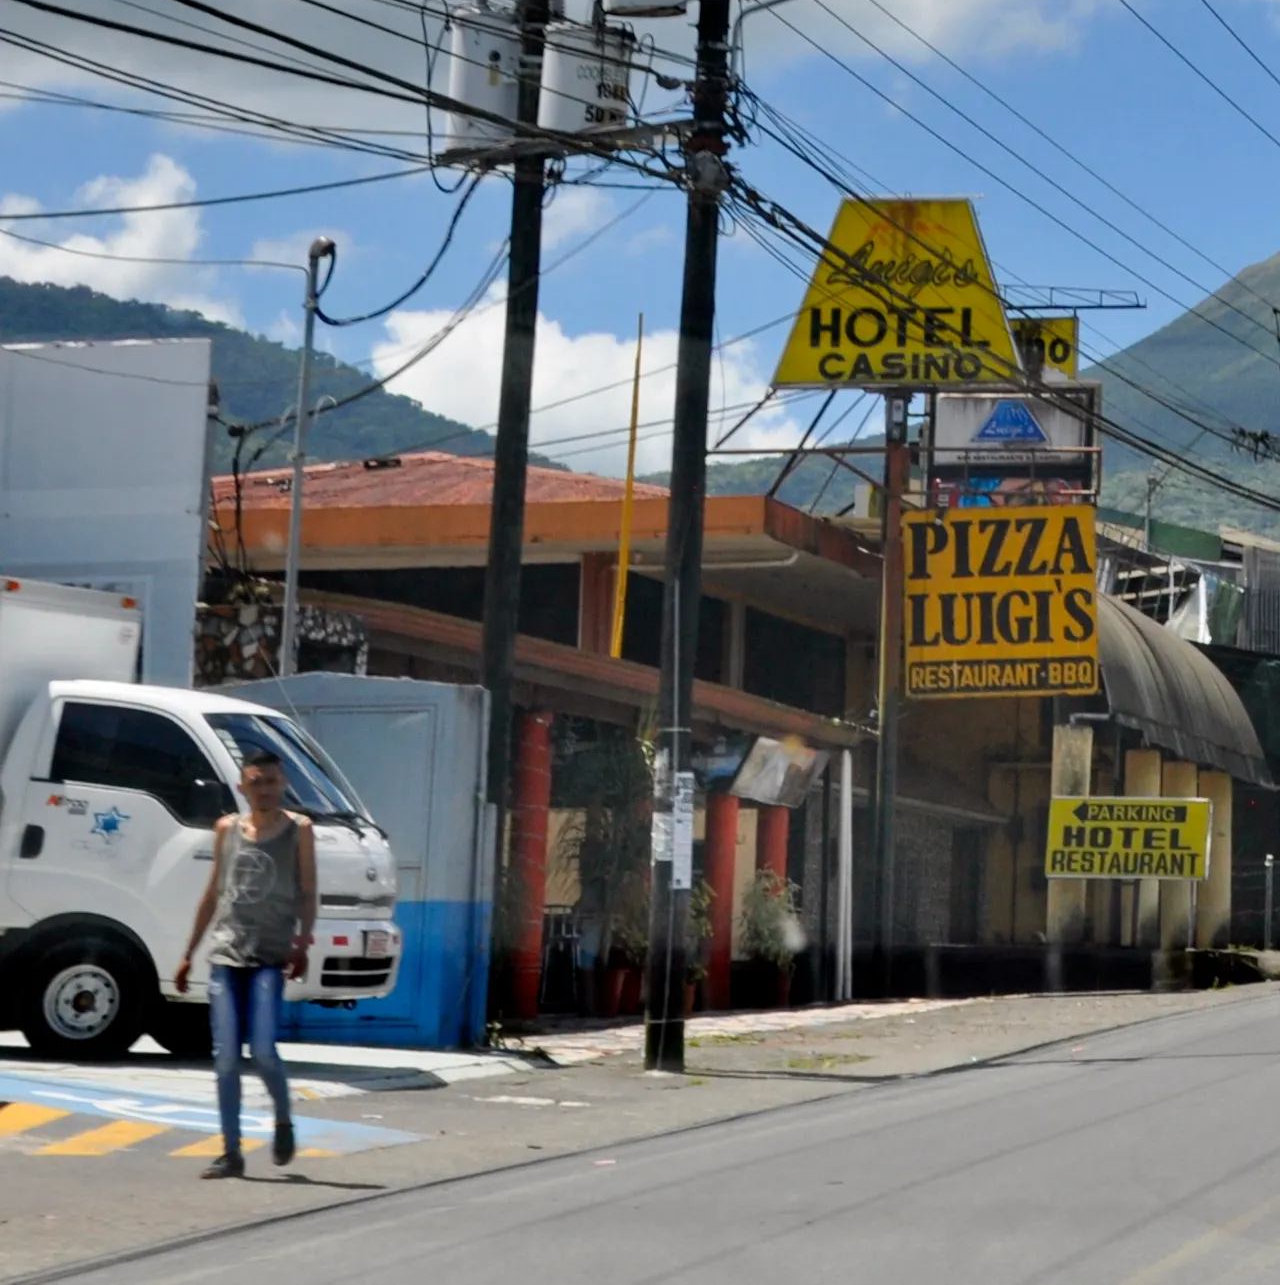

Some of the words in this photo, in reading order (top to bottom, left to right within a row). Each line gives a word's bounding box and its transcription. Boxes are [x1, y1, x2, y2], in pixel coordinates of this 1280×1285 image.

[809, 307, 990, 349] HOTEL
[818, 352, 983, 381] CASINO
[907, 517, 1093, 580] PIZZA
[907, 579, 1094, 648] LUIGI'S
[911, 662, 1040, 690] RESTAURANT
[1047, 661, 1093, 686] BBQ
[1087, 805, 1177, 821] PARKING
[1063, 825, 1191, 851] HOTEL
[1051, 850, 1202, 876] RESTAURANT
